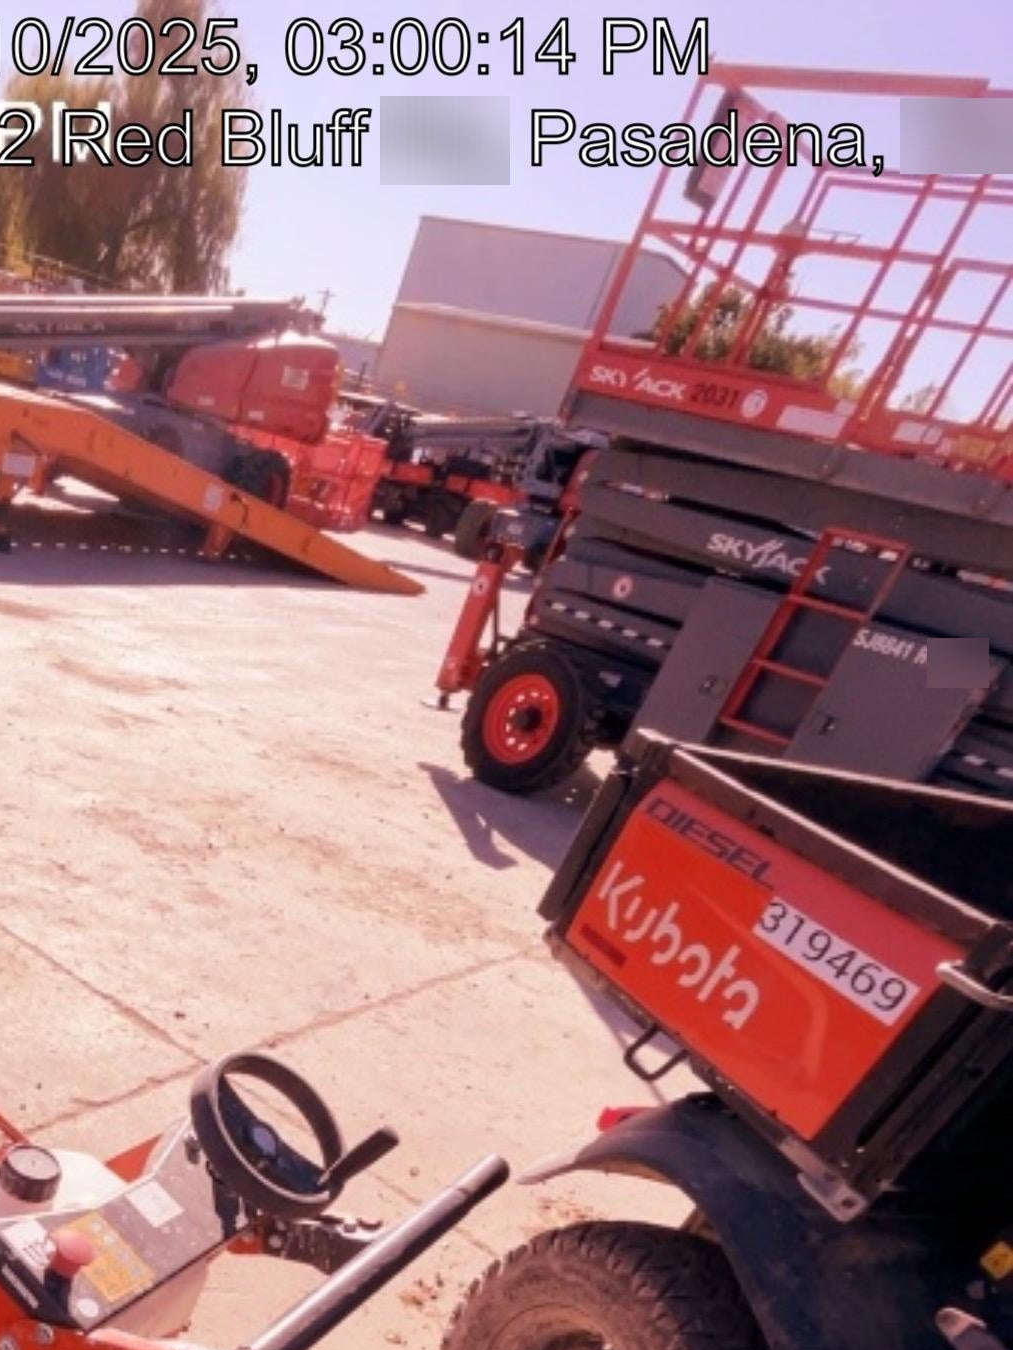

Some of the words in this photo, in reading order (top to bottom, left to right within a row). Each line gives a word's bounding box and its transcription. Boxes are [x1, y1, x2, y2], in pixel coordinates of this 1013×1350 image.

[706, 532, 831, 585] SKYJACK
[646, 797, 776, 889] DIESEL
[598, 861, 759, 1030] Kubota
[757, 901, 908, 1013] 319469
